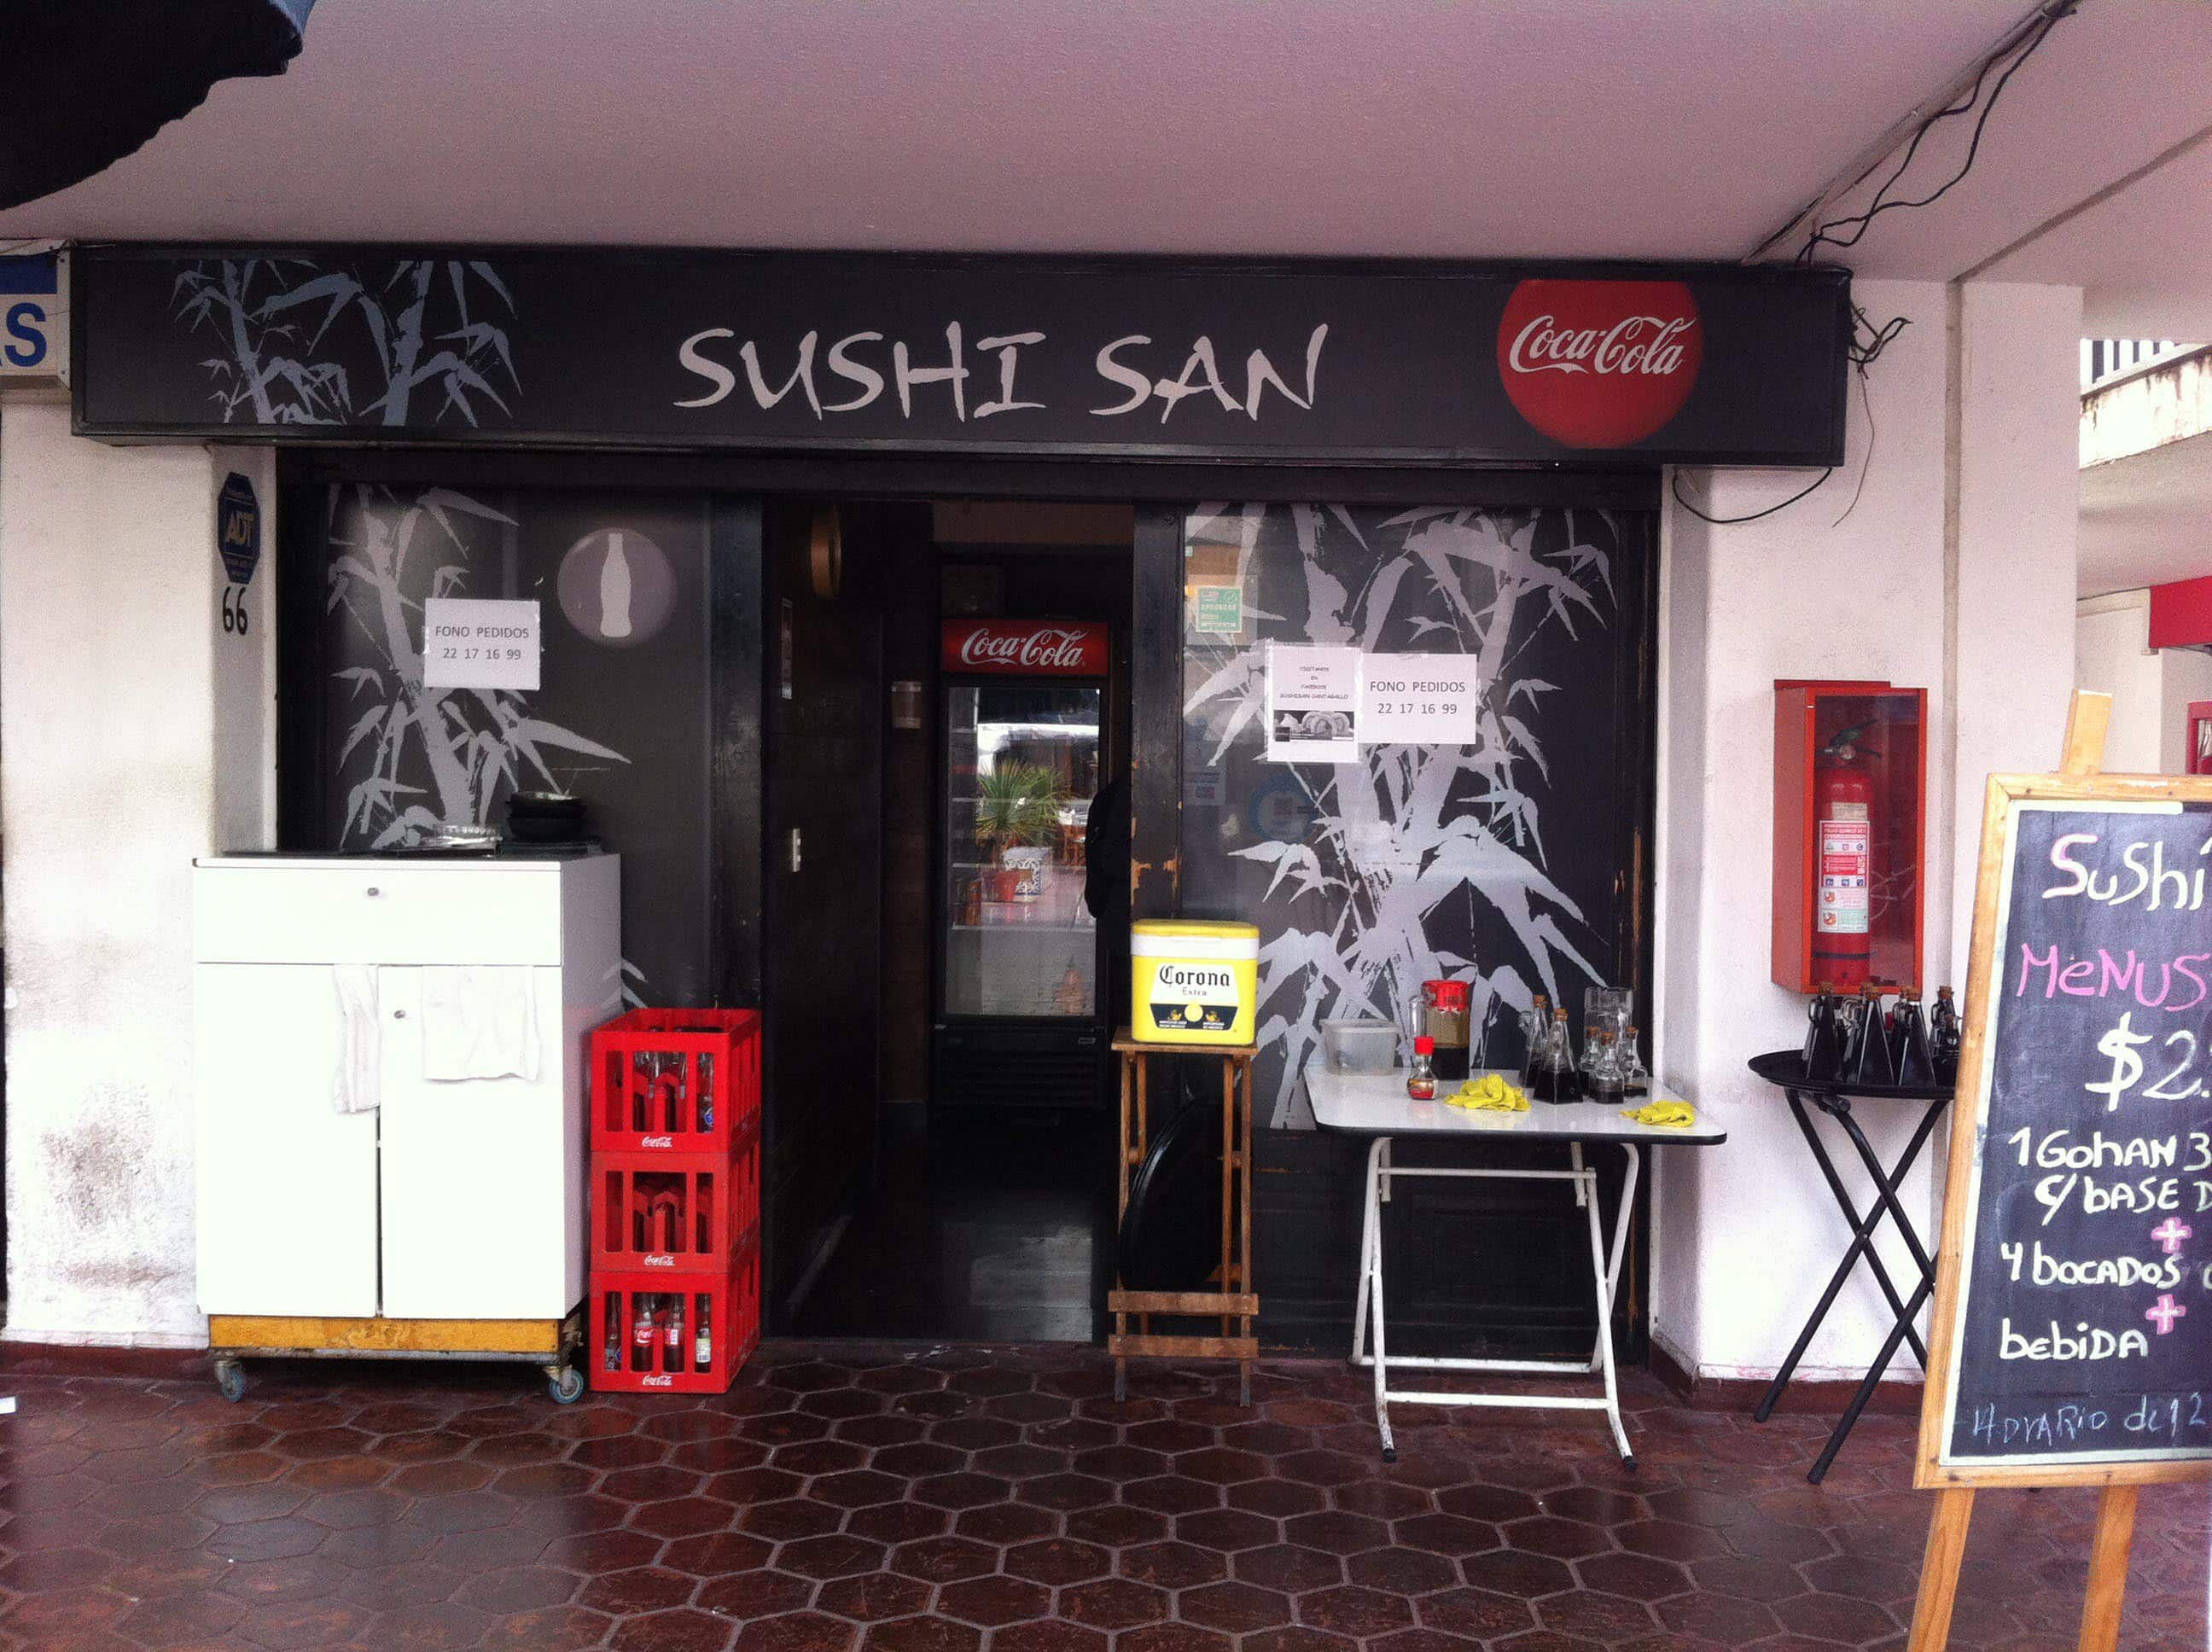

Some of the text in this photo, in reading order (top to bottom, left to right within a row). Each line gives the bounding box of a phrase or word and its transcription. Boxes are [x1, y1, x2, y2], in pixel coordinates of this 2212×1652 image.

[0, 302, 47, 367] S
[1510, 315, 1697, 375] Coca-Cola
[673, 321, 1328, 423] SUSHI SAN
[224, 510, 254, 547] ADT
[222, 586, 248, 636] 66
[434, 626, 530, 638] FONO PEDIDOS
[961, 627, 1089, 667] Coca-Cola
[443, 648, 521, 660] 22 17 16 99
[1370, 681, 1466, 693] FONO PEDIDOS
[1377, 702, 1458, 715] 22 17 16 99
[1160, 965, 1230, 987] Corona
[2085, 1011, 2212, 1112] $2.
[2008, 1126, 2031, 1166] 1
[2000, 1242, 2023, 1282] 4
